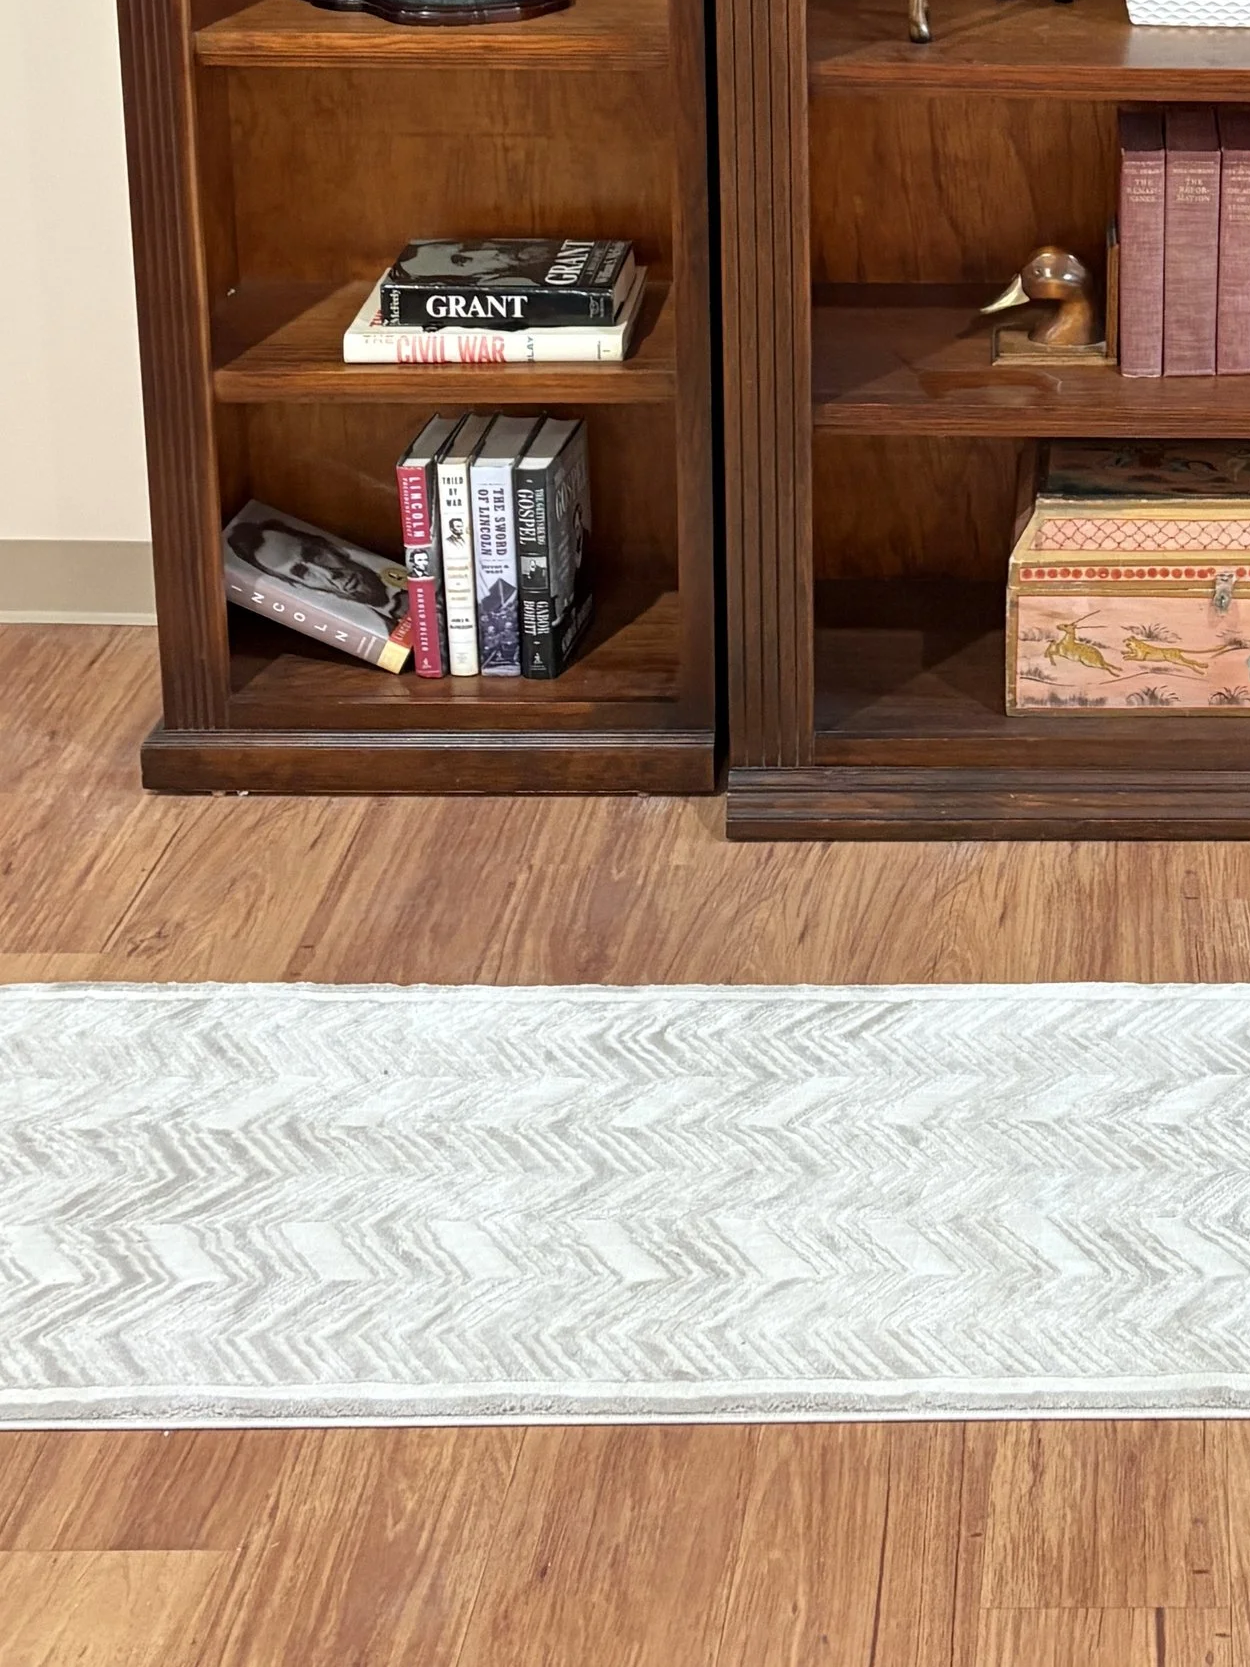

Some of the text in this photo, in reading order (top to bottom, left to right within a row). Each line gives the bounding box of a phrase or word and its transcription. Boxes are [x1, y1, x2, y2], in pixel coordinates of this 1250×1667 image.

[545, 239, 596, 285] GRANT
[425, 294, 529, 319] GRANT
[396, 334, 448, 366] CIVIL
[457, 335, 508, 366] WAR
[442, 476, 463, 485] TRIED
[449, 488, 457, 496] BY
[408, 476, 425, 538] LINCOLN
[446, 499, 462, 507] WAR
[493, 488, 505, 512] THE
[478, 489, 492, 556] OF LINCOLN
[517, 489, 537, 545] GOSPEL
[494, 516, 508, 556] SWORD
[231, 584, 349, 643] INCOLN
[536, 601, 550, 634] GABOR
